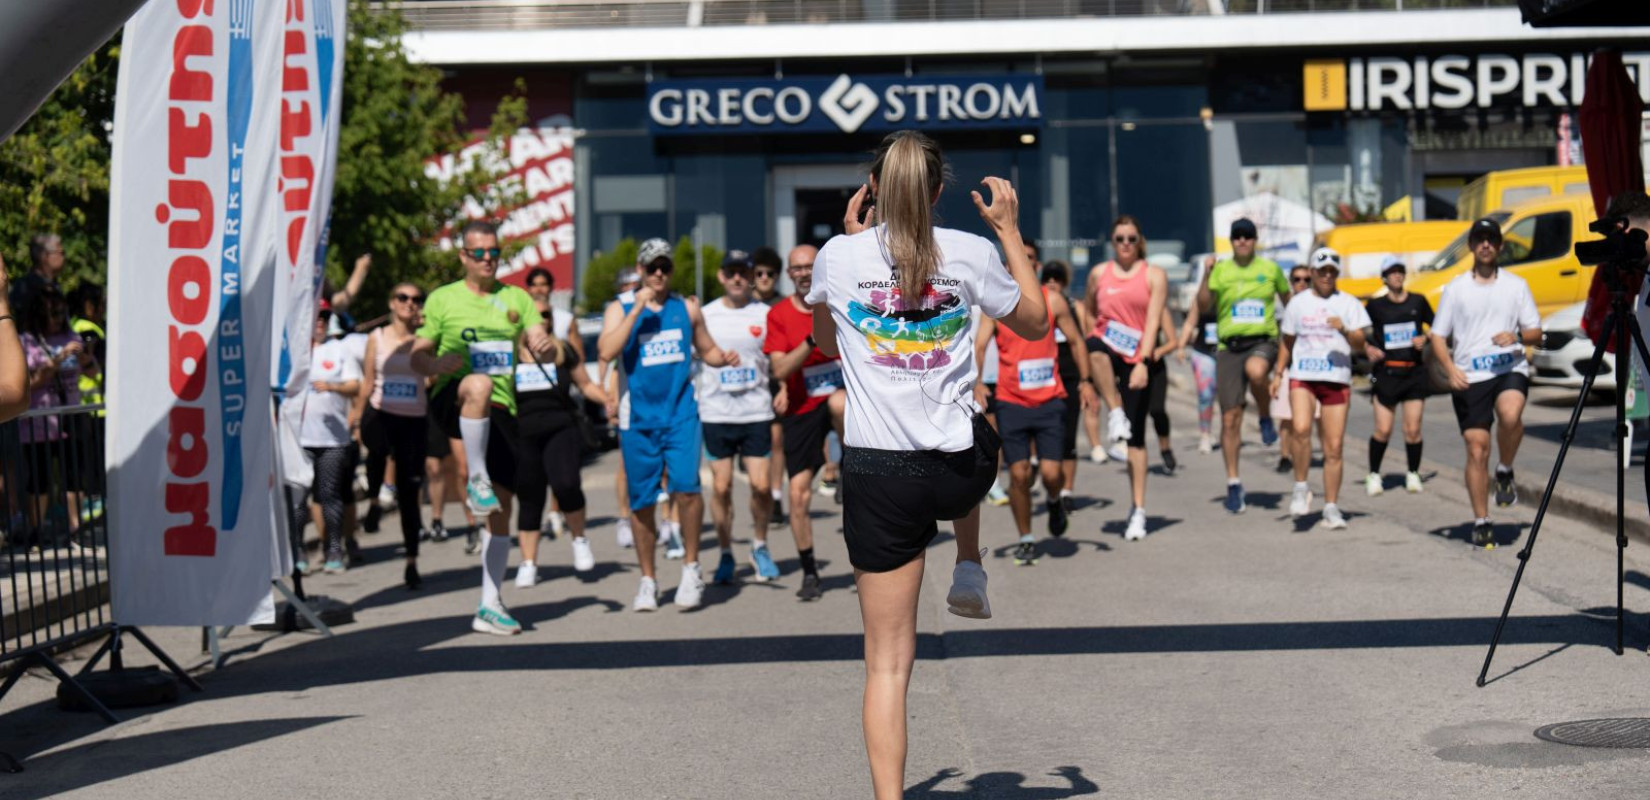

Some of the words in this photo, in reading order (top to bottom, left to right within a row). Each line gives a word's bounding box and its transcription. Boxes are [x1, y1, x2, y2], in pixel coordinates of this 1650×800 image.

[648, 86, 812, 126] GRECO
[884, 83, 1041, 122] STROM
[1350, 52, 1650, 111] IRISPRIT
[222, 142, 244, 295] MARKET
[221, 317, 244, 437] SUPER
